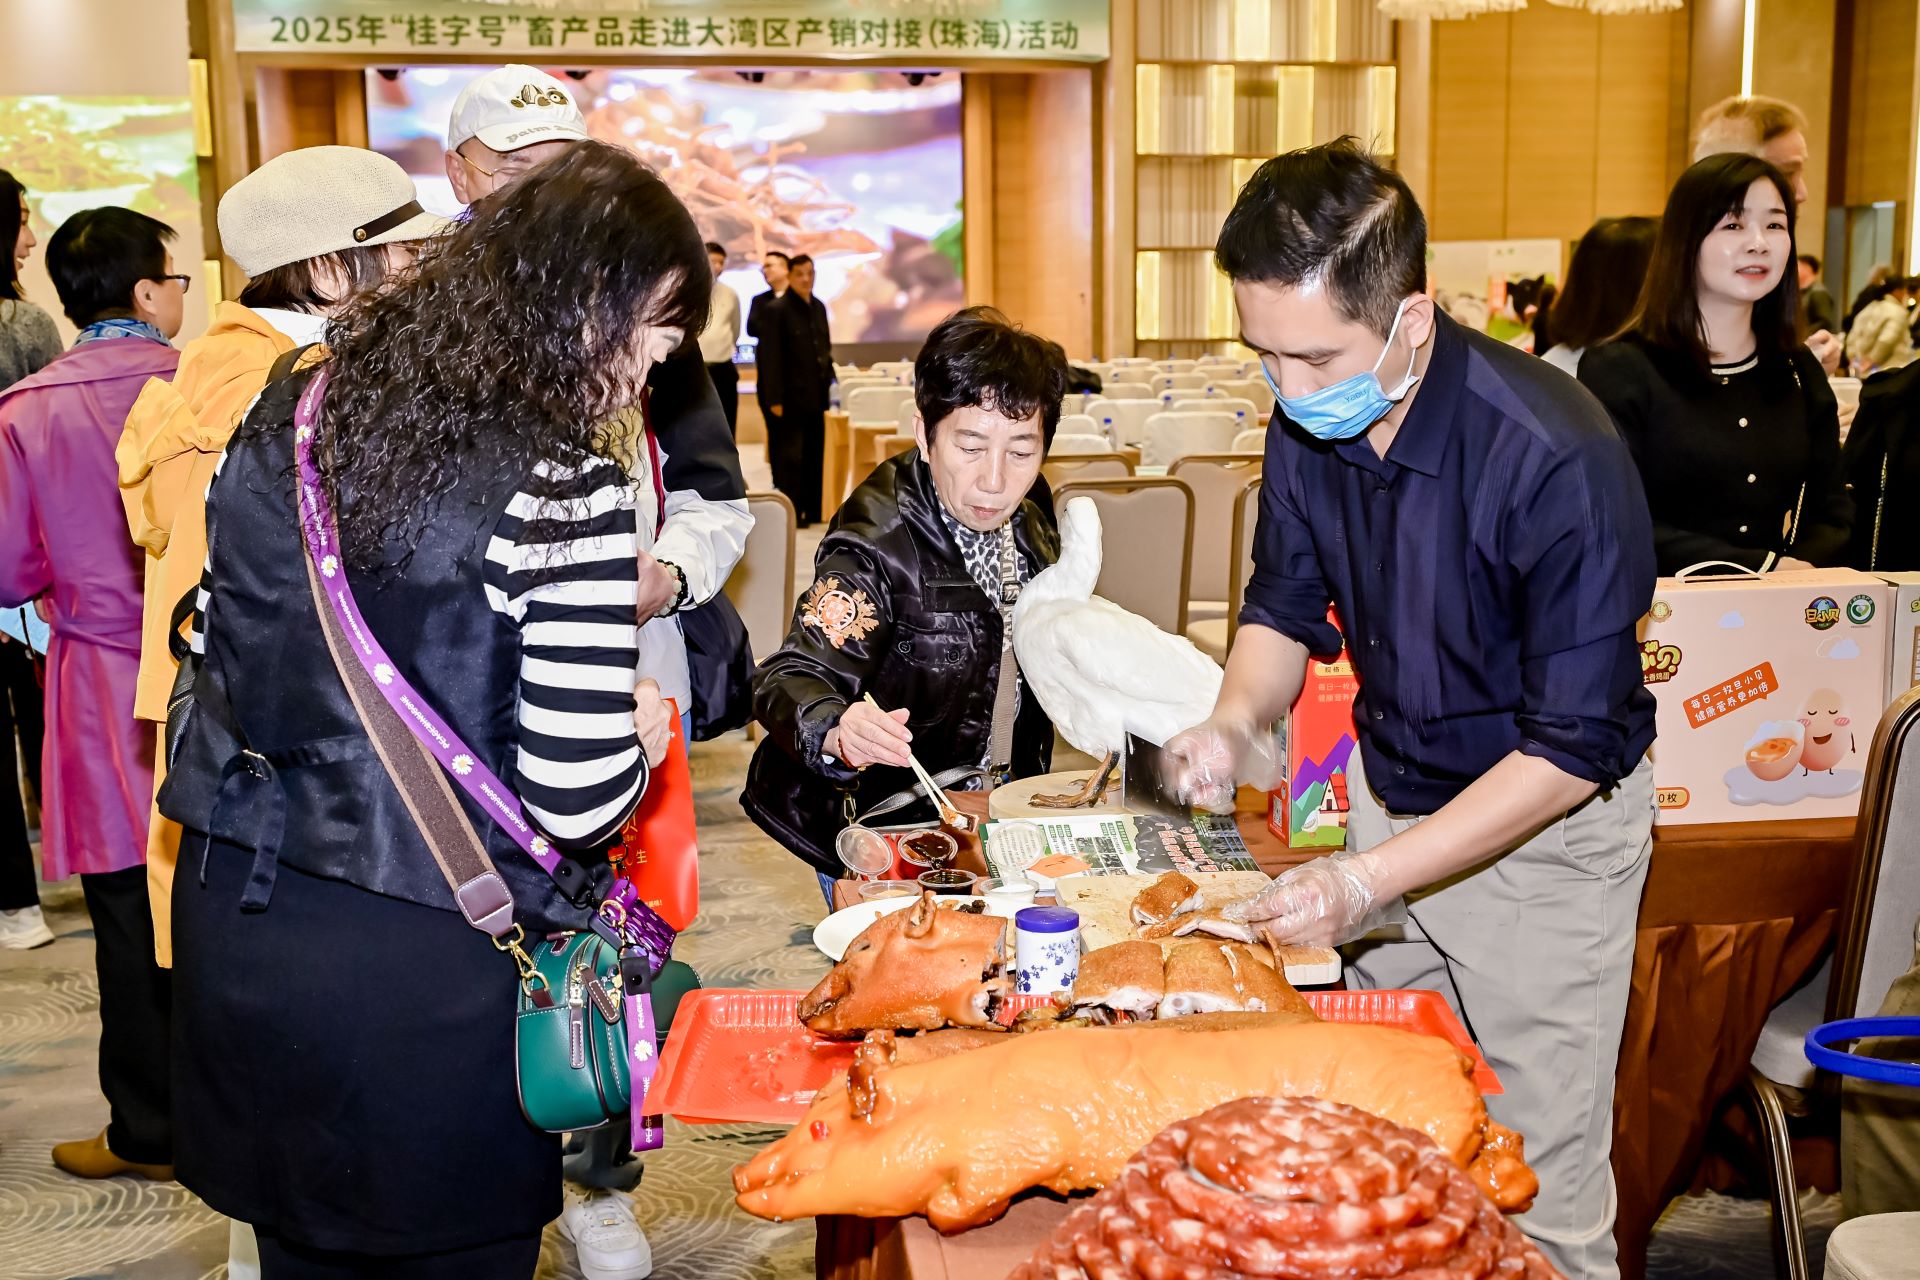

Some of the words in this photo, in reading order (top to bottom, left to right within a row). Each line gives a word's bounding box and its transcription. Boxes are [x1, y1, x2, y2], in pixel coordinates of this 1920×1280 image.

[1691, 669, 1763, 709] 每日一枚旦小贝
[1695, 682, 1768, 722] 健康营养更加倍
